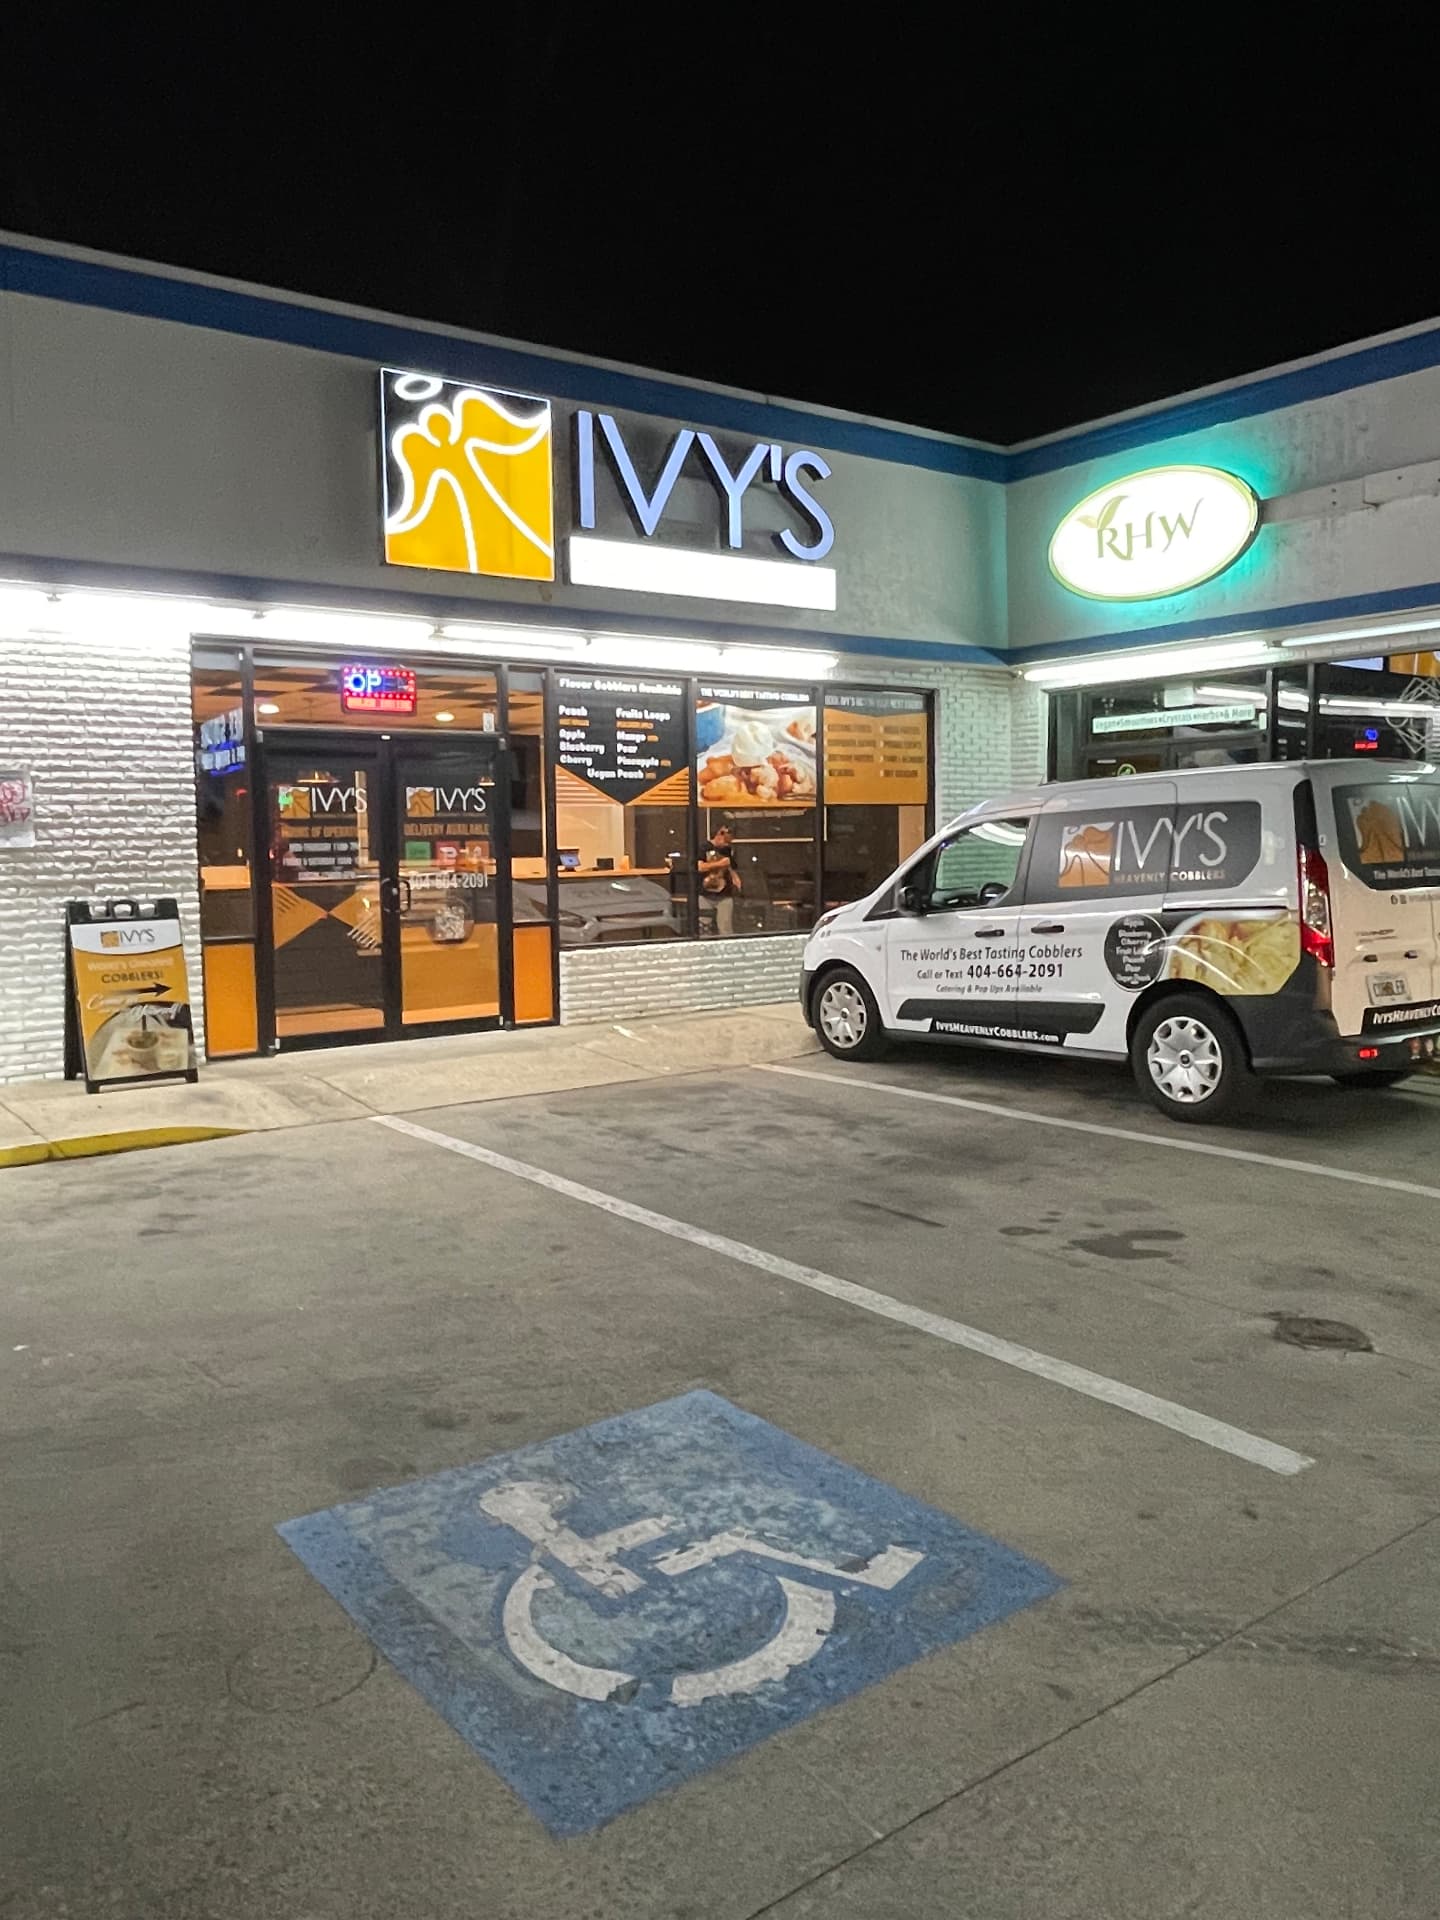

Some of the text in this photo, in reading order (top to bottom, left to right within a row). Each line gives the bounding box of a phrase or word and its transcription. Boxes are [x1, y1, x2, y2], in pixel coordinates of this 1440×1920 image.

[577, 410, 836, 561] IVY'S
[1097, 498, 1204, 561] RHW
[558, 705, 588, 716] Peach
[559, 729, 585, 741] Apple
[616, 730, 647, 743] Mango
[559, 741, 605, 755] Blueberry
[616, 743, 638, 753] Pear
[559, 755, 593, 767] Cherry
[617, 769, 644, 779] Peach
[311, 787, 367, 813] IVY'S
[435, 787, 486, 812] IVY'S
[1114, 811, 1229, 871] IVY'S
[1169, 869, 1226, 881] COBBLERS
[120, 929, 155, 943] IVY'S
[901, 944, 1083, 963] The World's Best Tasting Cobblers
[917, 969, 933, 980] Call
[945, 969, 963, 980] Text
[967, 963, 1063, 979] 404-664-2091
[936, 984, 966, 995] Catering
[974, 985, 988, 995] Pop
[1005, 984, 1043, 993] Available
